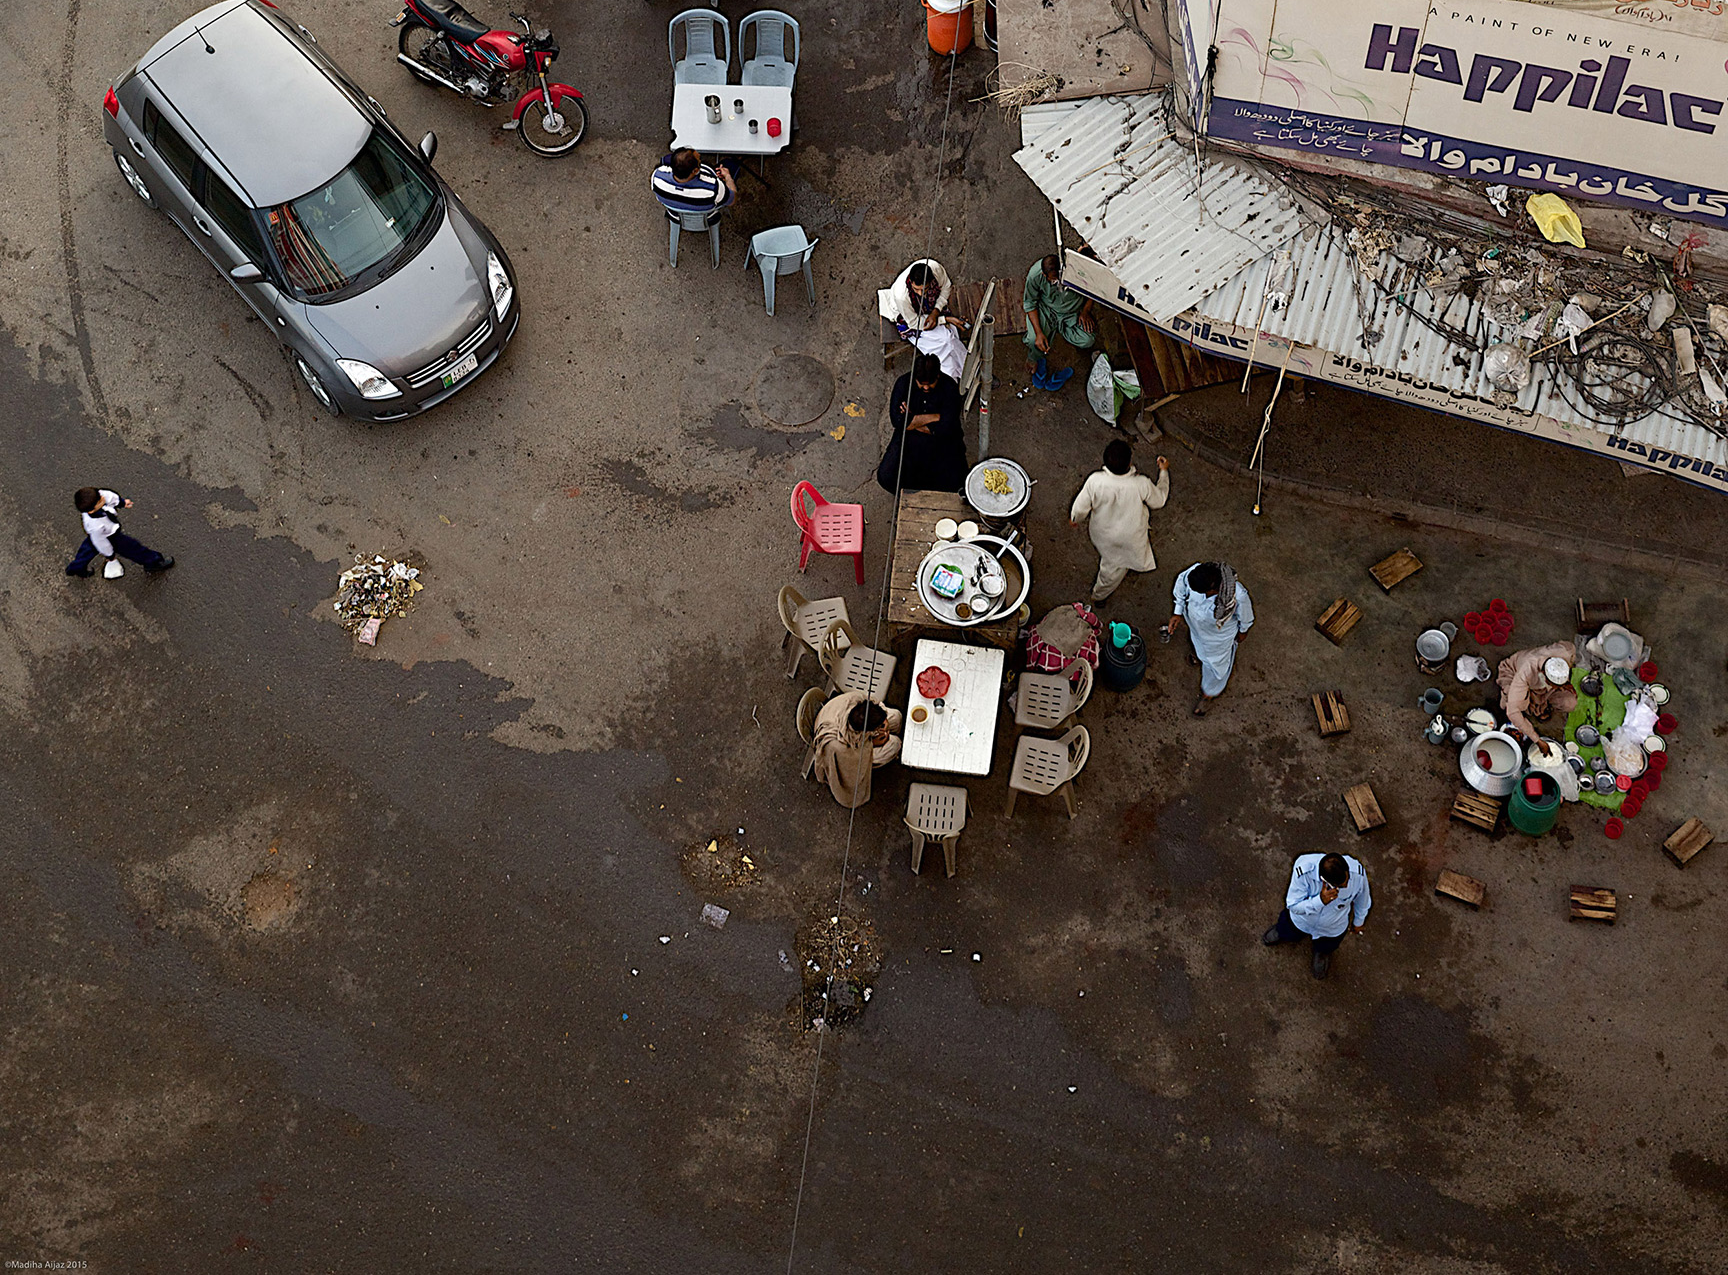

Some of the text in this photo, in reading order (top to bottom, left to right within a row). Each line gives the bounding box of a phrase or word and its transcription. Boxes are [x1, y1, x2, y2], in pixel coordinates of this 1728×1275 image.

[1430, 7, 1681, 63] A PAINT OF NEW ERA!
[1364, 23, 1725, 135] Happilac
[1400, 132, 1468, 170] والا
[1469, 155, 1579, 190] بادام
[1578, 176, 1664, 204] خان
[1333, 354, 1362, 373] والا
